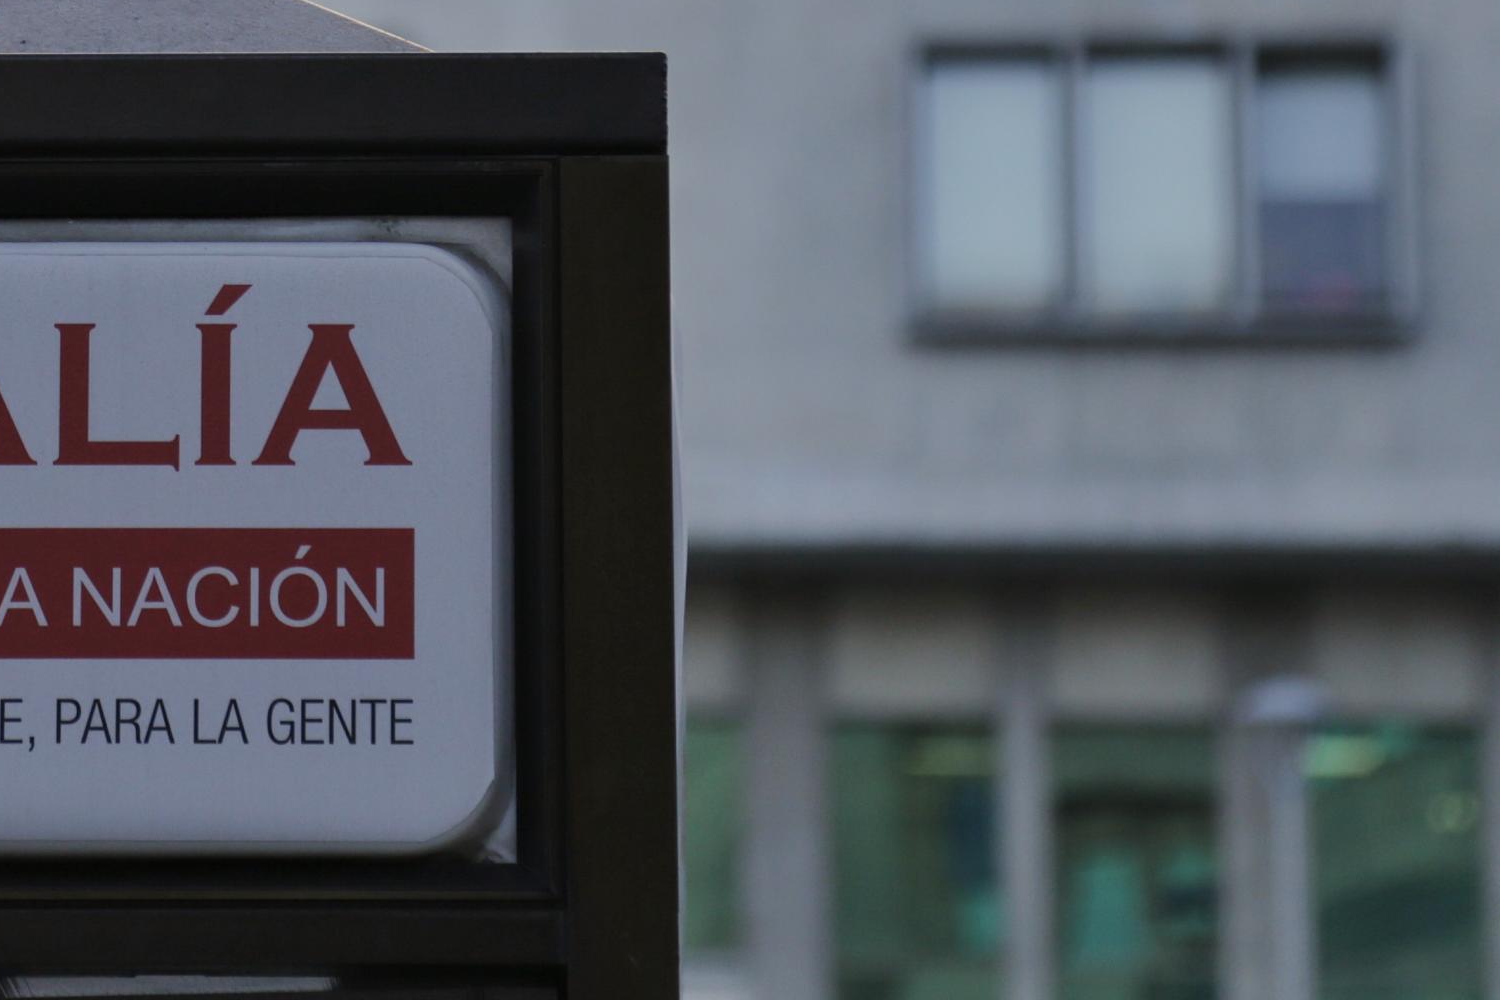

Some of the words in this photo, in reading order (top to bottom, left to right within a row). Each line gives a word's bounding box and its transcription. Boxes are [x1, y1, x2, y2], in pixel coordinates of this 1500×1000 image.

[73, 545, 384, 627] NACIÓN
[56, 699, 175, 744] PARA
[194, 699, 248, 744] LA
[267, 698, 414, 745] GENTE
